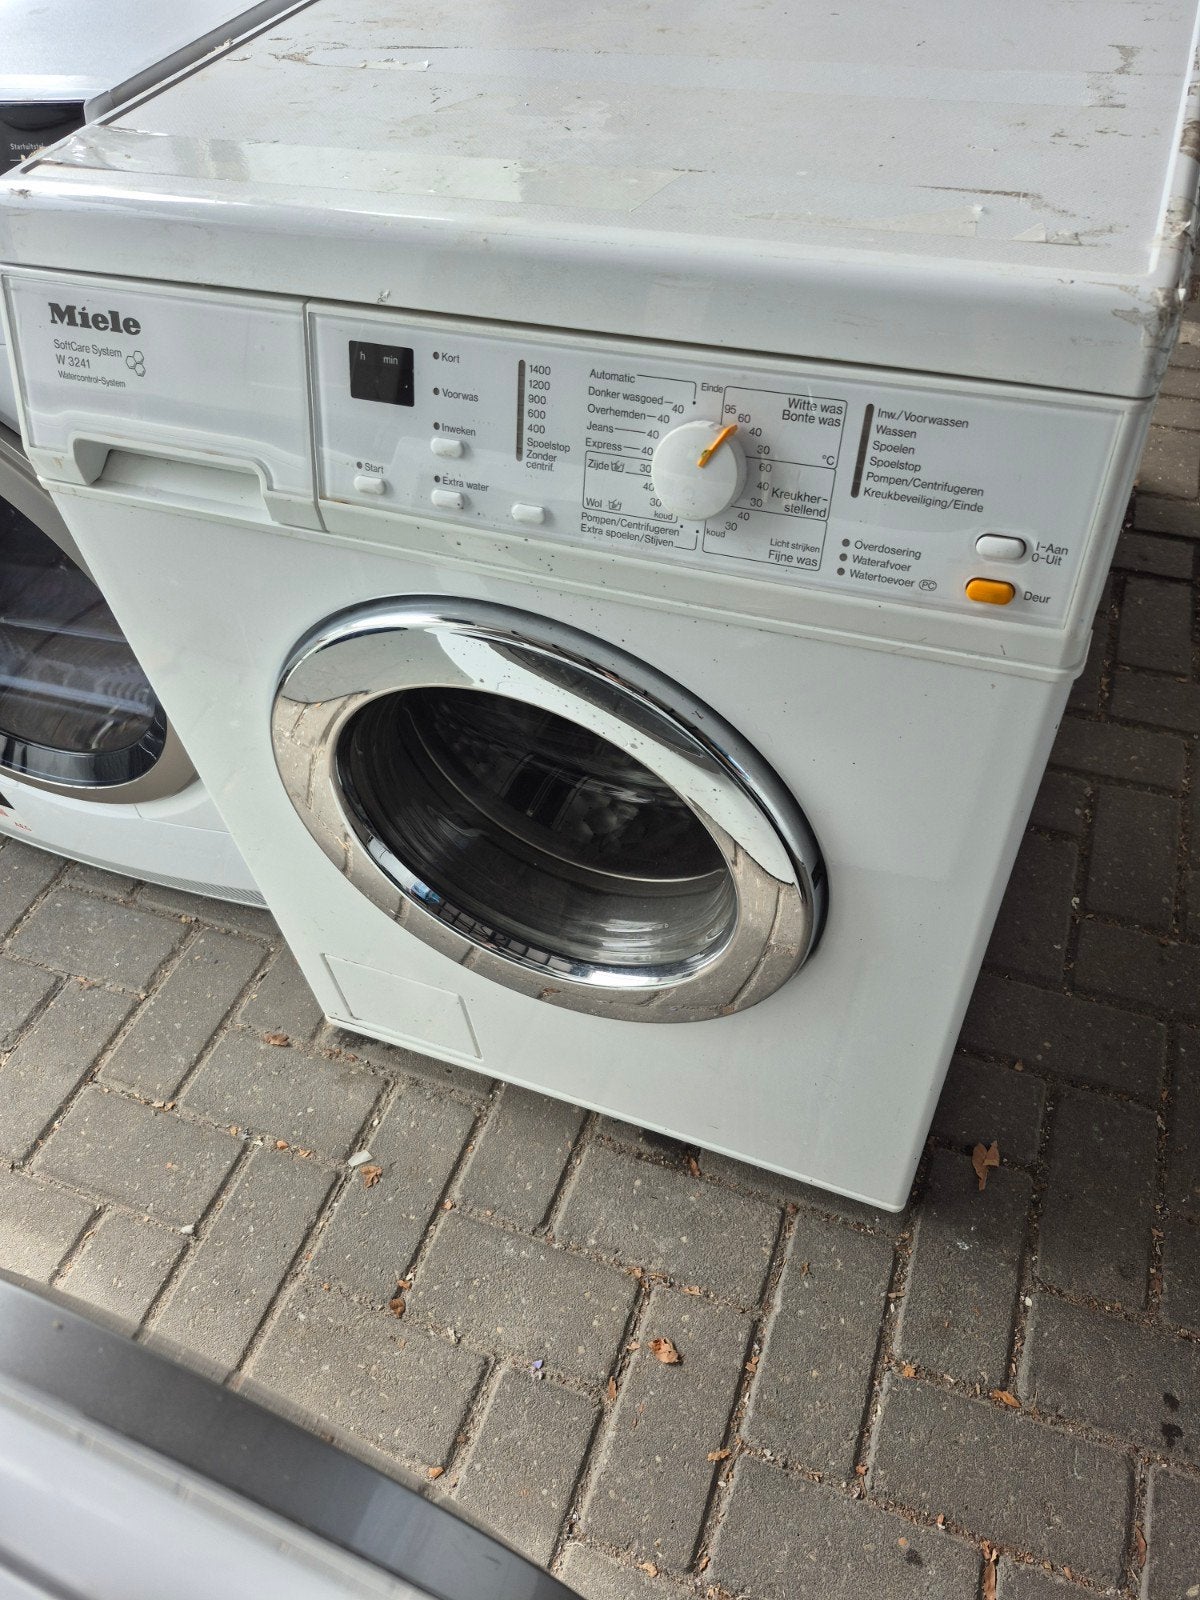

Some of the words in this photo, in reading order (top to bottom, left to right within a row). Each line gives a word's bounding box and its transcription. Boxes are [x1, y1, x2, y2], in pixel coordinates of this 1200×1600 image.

[48, 302, 142, 335] Miele
[54, 339, 91, 354] SoftCare
[92, 344, 122, 358] System
[56, 354, 66, 366] W
[68, 356, 91, 368] 3241
[360, 351, 366, 360] h
[384, 356, 398, 365] min
[442, 352, 460, 364] Kort
[529, 364, 551, 376] 1400
[590, 369, 636, 384] Automatic
[58, 370, 126, 388] Watercontrol-System
[528, 380, 550, 390] 1200
[442, 388, 479, 402] Voorwas
[701, 382, 724, 394] Einde
[528, 395, 546, 405] 900
[588, 386, 620, 400] Donker
[622, 392, 664, 406] wasgoed
[672, 404, 684, 414] 40
[788, 397, 818, 412] Witte
[820, 404, 843, 415] was
[528, 410, 546, 420] 600
[588, 404, 646, 420] Overhemden
[657, 414, 670, 424] 40
[724, 404, 737, 414] 95
[738, 414, 751, 424] 60
[782, 410, 816, 424] Bonte
[818, 416, 842, 428] was
[878, 408, 969, 429] Inw./Voorwassen
[442, 422, 476, 436] Inweken
[528, 424, 546, 434] 400
[587, 421, 614, 434] Jeans
[647, 429, 660, 440] 40
[748, 427, 762, 438] 40
[876, 424, 917, 438] Wassen
[527, 438, 570, 453] Spoelstop
[586, 438, 622, 452] Express
[641, 446, 654, 456] 40
[757, 444, 770, 455] 30
[872, 440, 915, 456] Spoelen
[526, 450, 557, 462] Zonder
[364, 462, 384, 474] Start
[526, 461, 554, 472] centrif.
[588, 458, 610, 471] Zijde
[640, 464, 652, 474] 30
[759, 463, 772, 473] 60
[870, 456, 922, 472] Spoelstop
[443, 477, 464, 488] Extra
[466, 482, 489, 492] water
[642, 482, 654, 492] 40
[756, 481, 770, 492] 40
[866, 472, 984, 498] Pompen/Centrifugeren
[772, 487, 828, 503] Kreukher-
[863, 487, 984, 512] Kreukbeveiliging/Einde
[586, 497, 602, 508] Wol
[650, 498, 662, 508] 30
[750, 497, 762, 508] 30
[784, 501, 826, 518] stellend
[654, 510, 673, 520] koud
[738, 511, 750, 522] 40
[581, 512, 680, 537] Pompen/Centrifugeren
[725, 522, 738, 532] 30
[580, 524, 603, 536] Extra
[606, 528, 674, 548] spoelen/Stijven
[706, 528, 726, 538] koud
[770, 538, 790, 549] Licht
[791, 542, 820, 554] strijken
[854, 540, 922, 560] Overdosering
[768, 550, 794, 564] Fijne
[797, 556, 818, 567] was
[852, 554, 912, 572] Waterafvoer
[850, 569, 914, 588] Watertoevoer
[920, 580, 936, 590] PC
[1024, 591, 1051, 604] Deur
